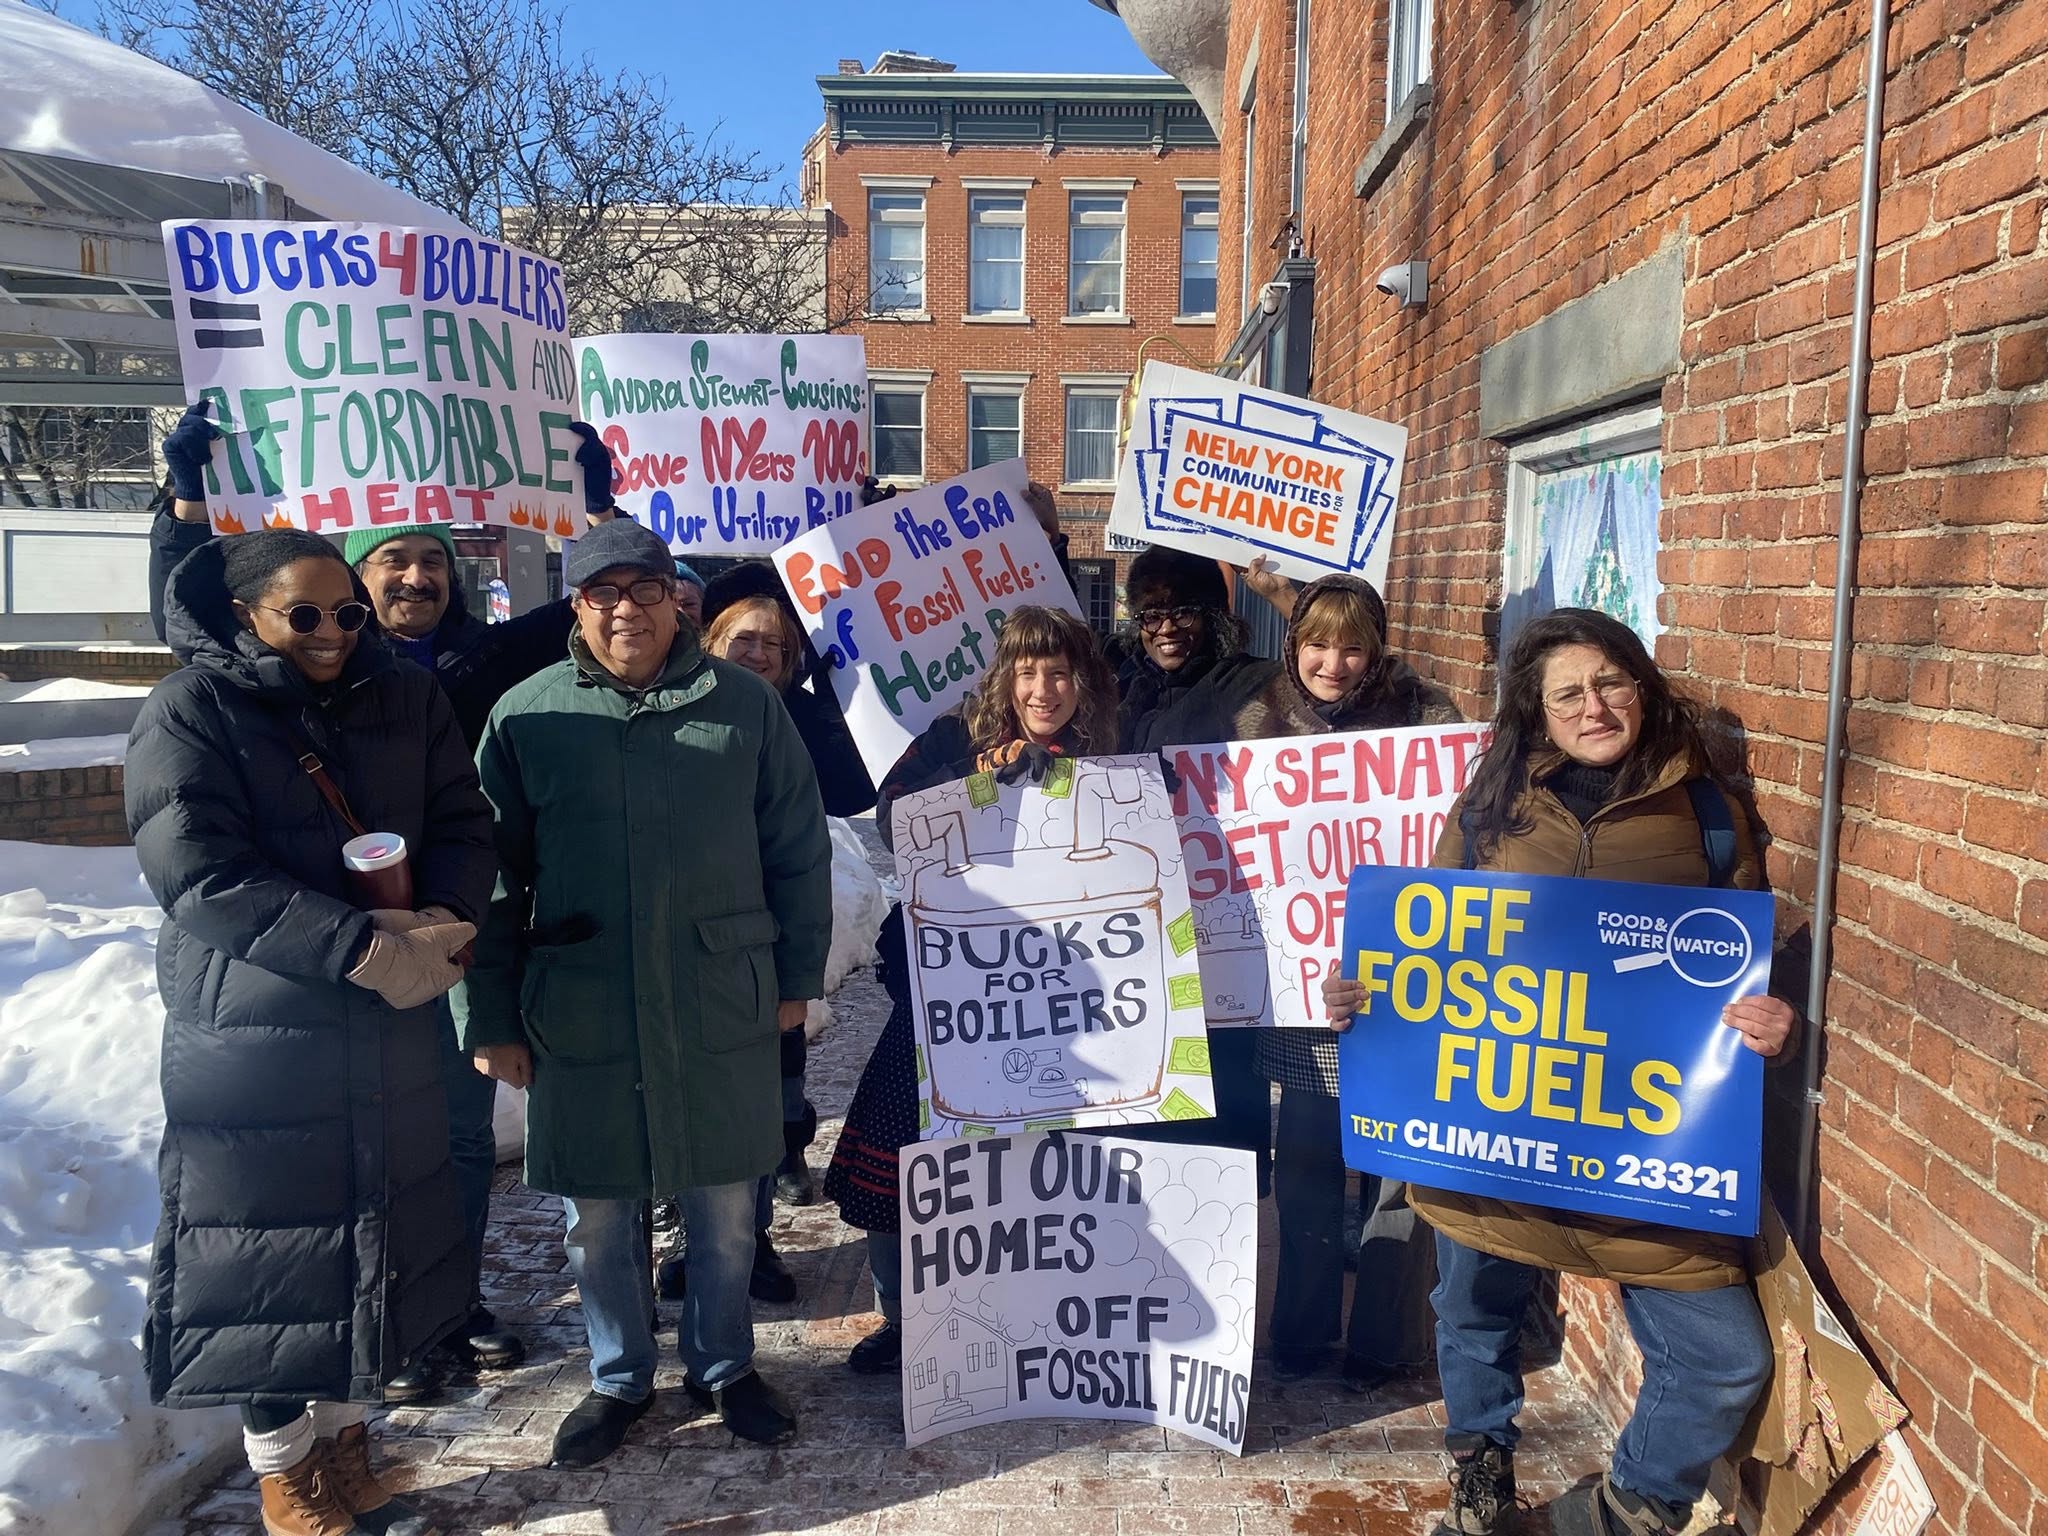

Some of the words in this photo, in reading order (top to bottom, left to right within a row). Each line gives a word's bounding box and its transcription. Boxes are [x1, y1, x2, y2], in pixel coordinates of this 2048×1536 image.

[174, 225, 378, 294] BUCKS
[379, 231, 418, 296] 4
[423, 234, 567, 332] BOILERS
[284, 301, 516, 391] CLEAN
[532, 339, 576, 405] AND
[200, 385, 573, 497] AFFORDABLE
[603, 425, 688, 495] Save
[701, 416, 796, 484] NYers
[1184, 428, 1260, 469] NEW
[1264, 447, 1345, 492] YORK
[300, 484, 494, 531] HEAT
[650, 490, 707, 545] Our
[713, 486, 800, 545] Utility
[1173, 477, 1339, 547] CHANGE
[1182, 457, 1331, 508] COMMUNITIES
[1333, 494, 1344, 513] FOR
[785, 538, 891, 614] END
[894, 507, 952, 560] the
[944, 485, 1015, 539] ERA
[874, 566, 965, 642] Fossil
[962, 542, 1047, 604] Fuels:
[869, 621, 986, 716] Heat
[1172, 747, 1254, 817] NY
[1274, 731, 1497, 808] SENAT
[1179, 820, 1291, 901] GET
[1307, 816, 1386, 886] OUR
[918, 912, 1145, 970] BUCKS
[1394, 883, 1531, 957] OFF
[1599, 929, 1665, 950] WATER
[1673, 936, 1745, 958] WATCH
[927, 978, 1147, 1045] BOILERS
[984, 969, 1072, 997] FOR
[1357, 950, 1608, 1047] FOSSIL
[1435, 1032, 1683, 1136] FUELS
[906, 1137, 1012, 1225] GET
[1029, 1130, 1144, 1205] OUR
[1350, 1113, 1398, 1144] TEXT
[1403, 1117, 1559, 1174] CLIMATE
[1567, 1154, 1606, 1181] TO
[1614, 1153, 1738, 1202] 23321
[911, 1212, 1097, 1295] HOMES
[1055, 1295, 1169, 1343] OFF
[1016, 1346, 1158, 1412] FOSSIL
[1169, 1353, 1249, 1445] FUELS
